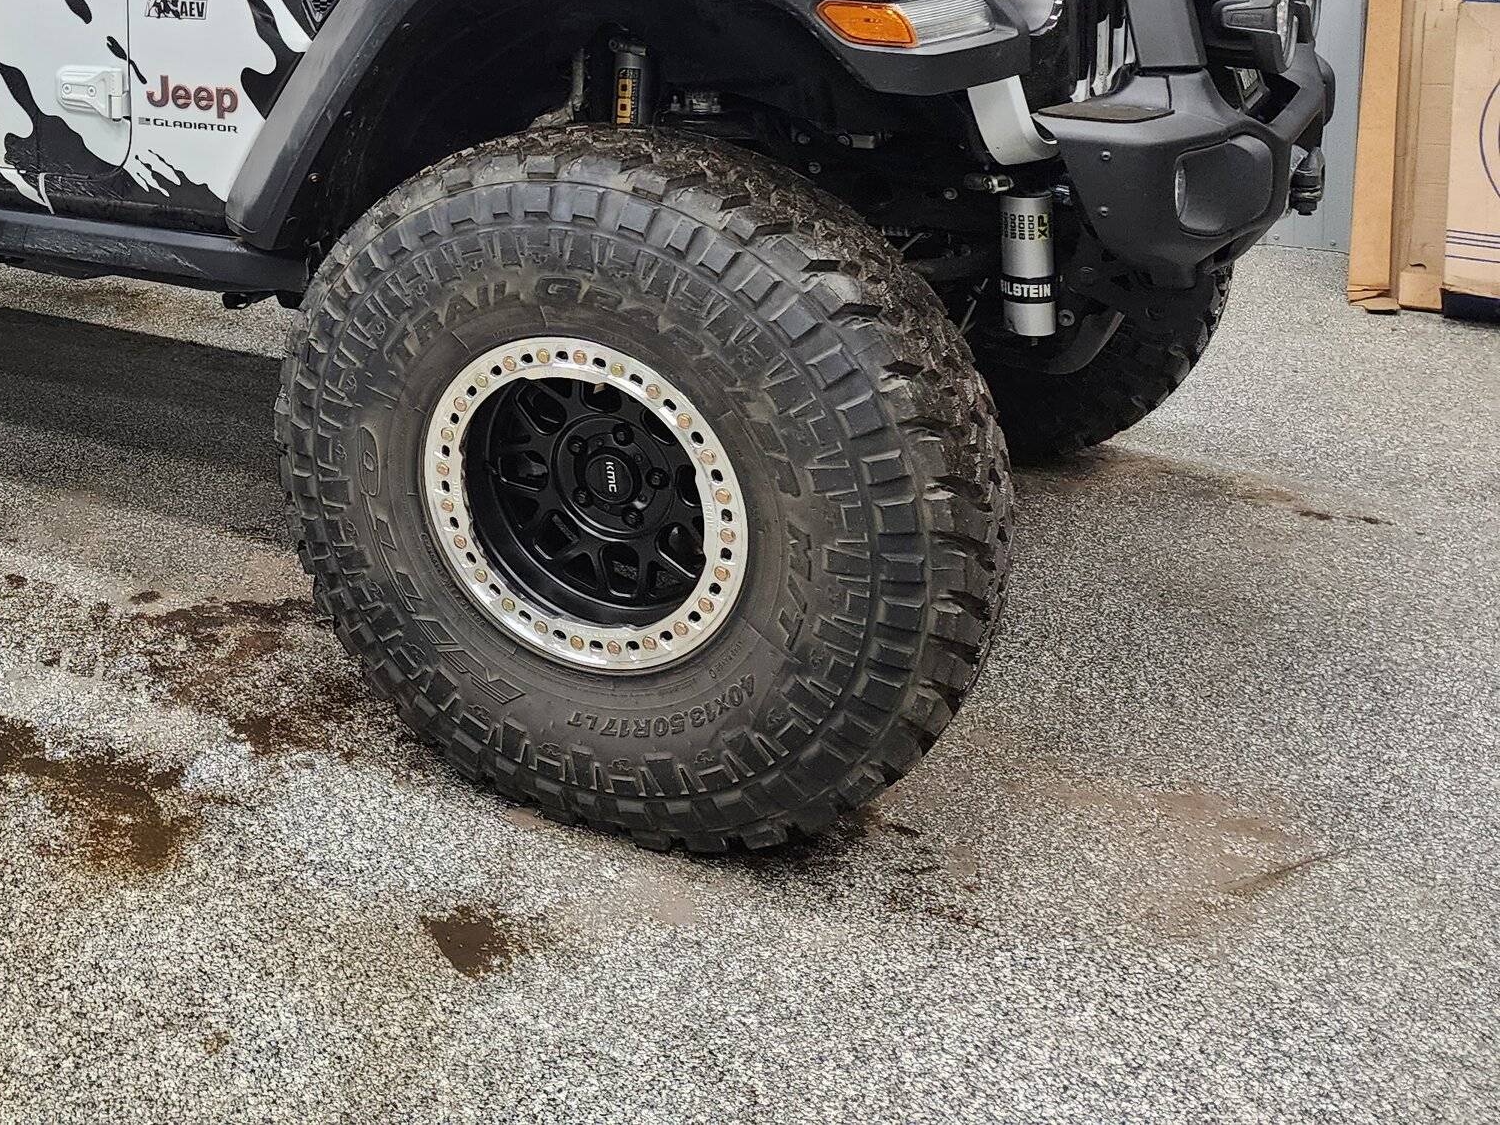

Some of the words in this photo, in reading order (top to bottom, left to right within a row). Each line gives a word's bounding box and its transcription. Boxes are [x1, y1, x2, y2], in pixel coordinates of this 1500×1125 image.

[180, 0, 207, 18] AEV
[146, 75, 239, 119] Jeep
[153, 118, 239, 134] GLADIATOR
[605, 461, 618, 493] KMC
